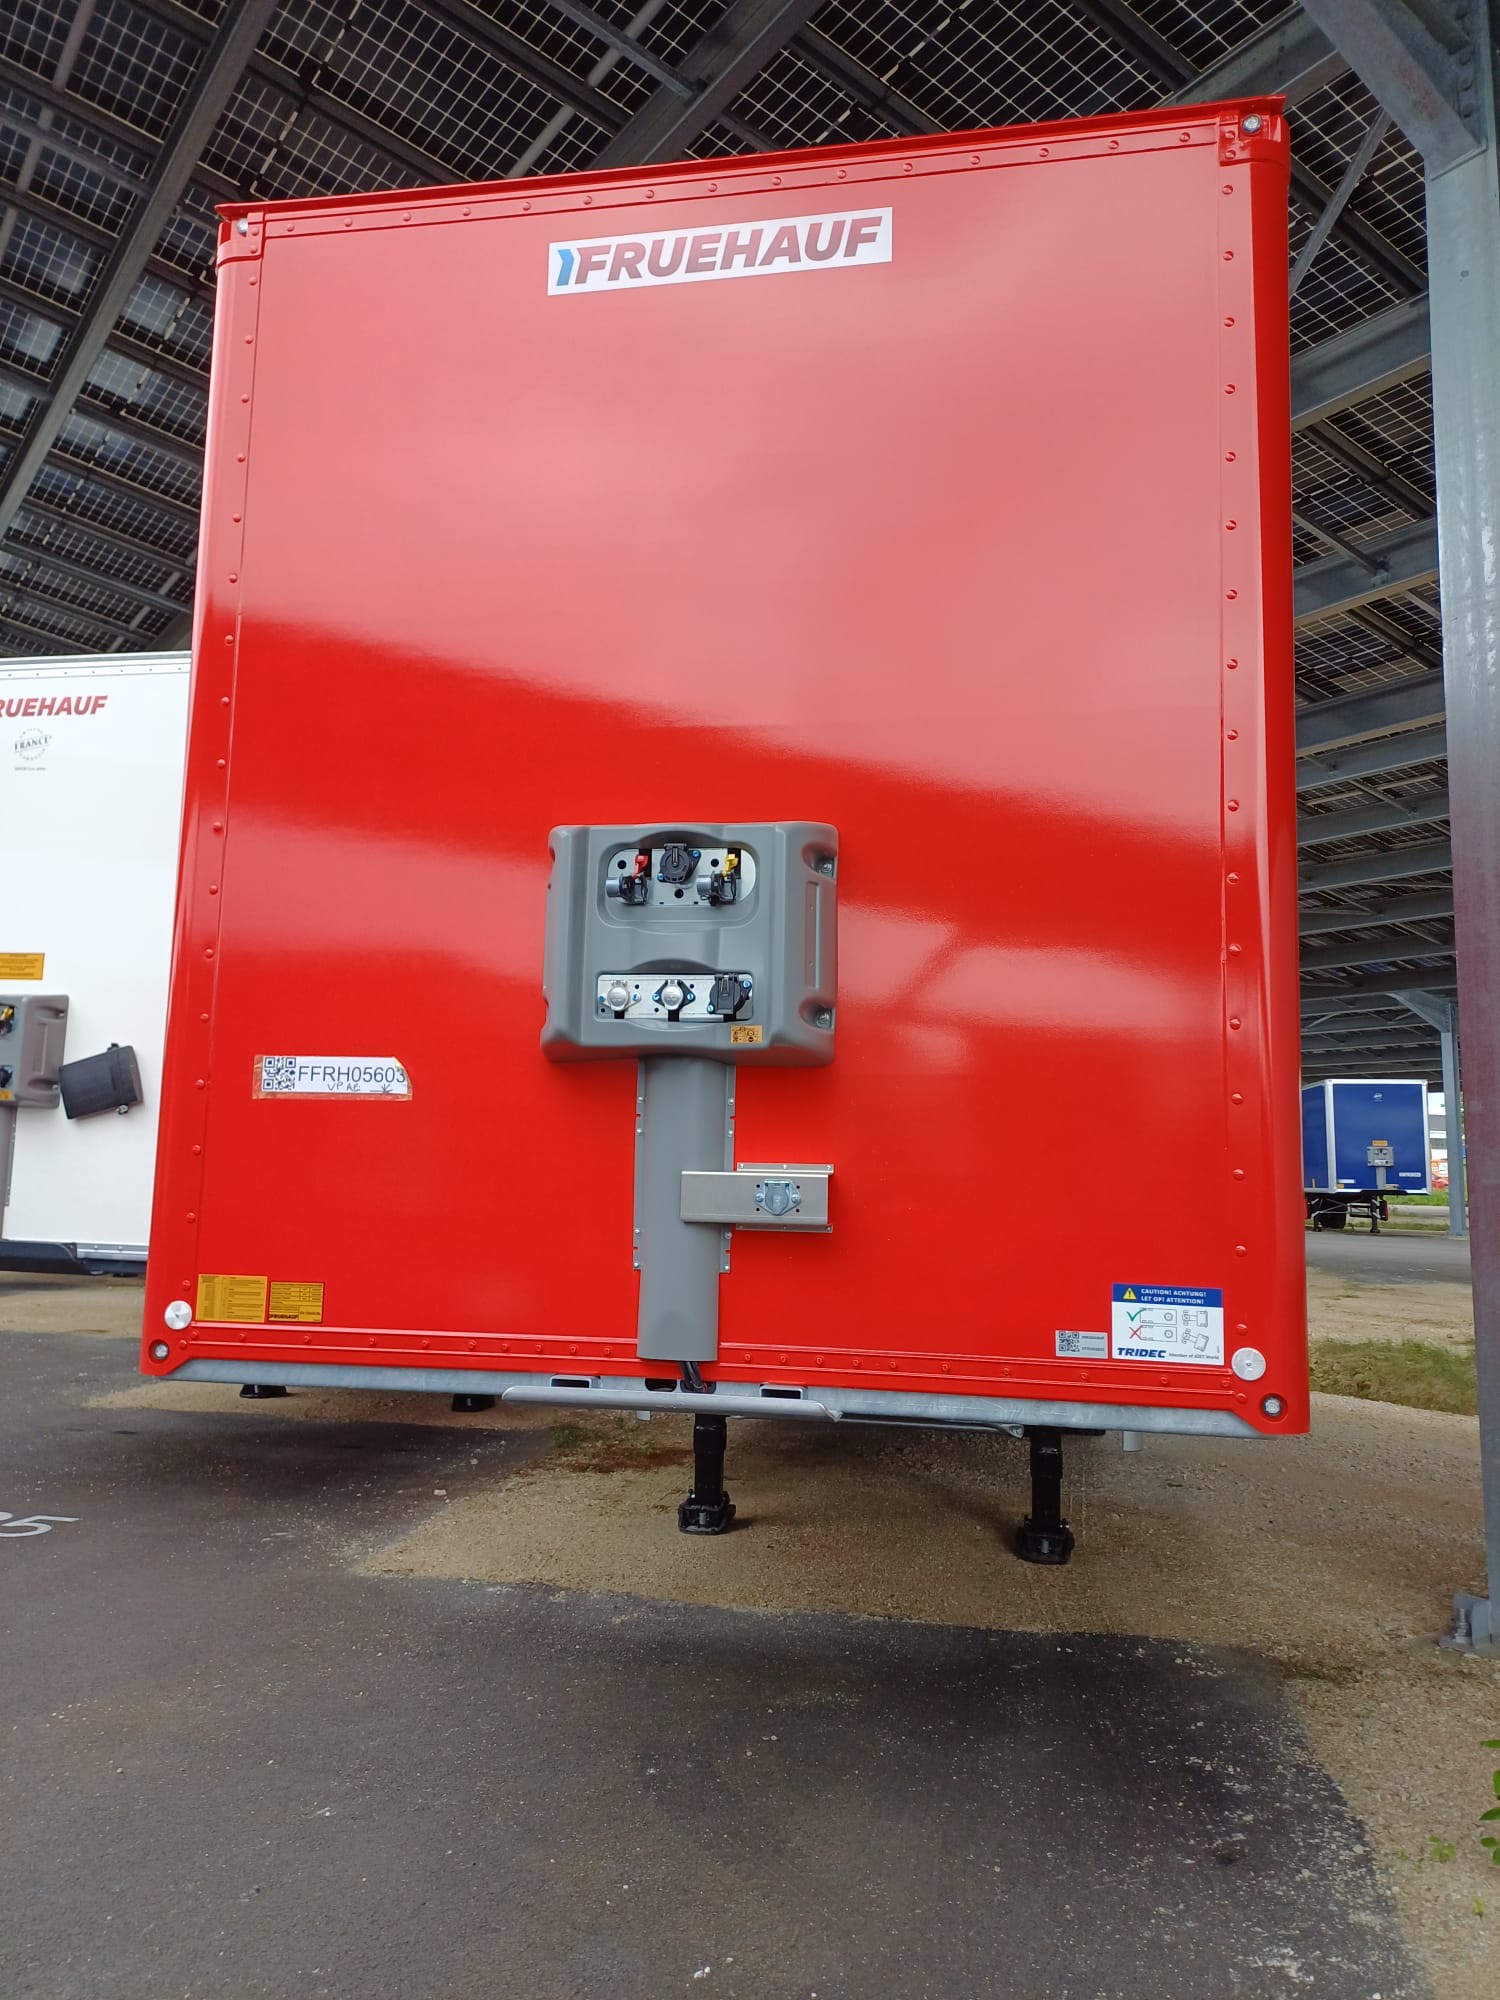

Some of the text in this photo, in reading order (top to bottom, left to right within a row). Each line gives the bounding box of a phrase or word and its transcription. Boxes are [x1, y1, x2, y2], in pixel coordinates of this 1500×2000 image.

[575, 216, 883, 285] FRUEHAUF
[298, 1065, 406, 1083] FFRH05603
[1141, 1288, 1207, 1298] CAUTION! ACHTUNG!
[1166, 1297, 1204, 1305] ATTENTION!
[1117, 1347, 1167, 1359] TRIDEC
